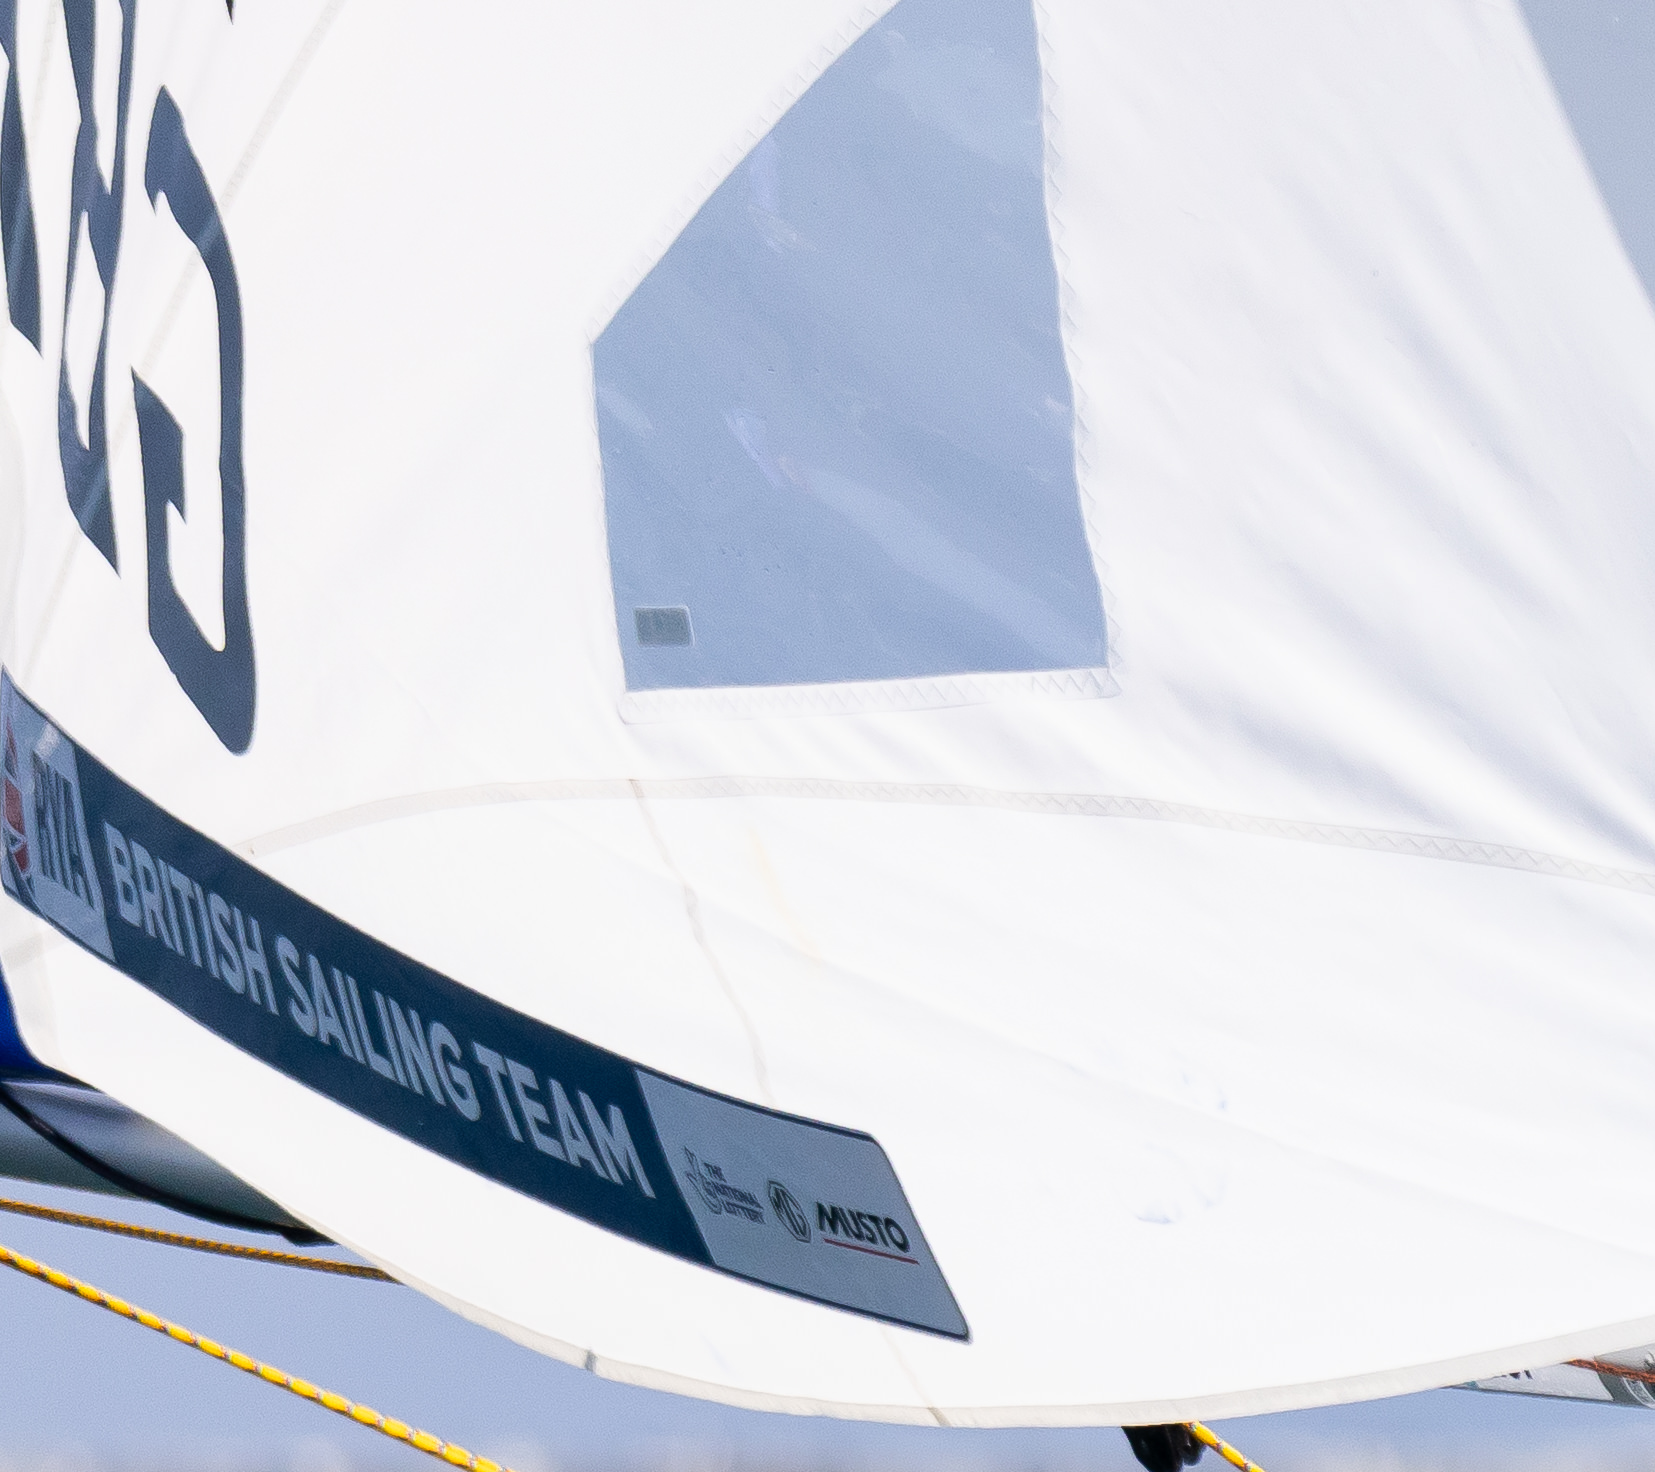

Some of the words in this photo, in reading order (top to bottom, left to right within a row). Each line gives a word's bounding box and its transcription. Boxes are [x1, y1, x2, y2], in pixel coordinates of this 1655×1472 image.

[103, 820, 280, 1017] BRITISH
[274, 933, 482, 1123] SAILING
[472, 1040, 657, 1200] TEAM
[815, 1200, 911, 1253] MUSTO
